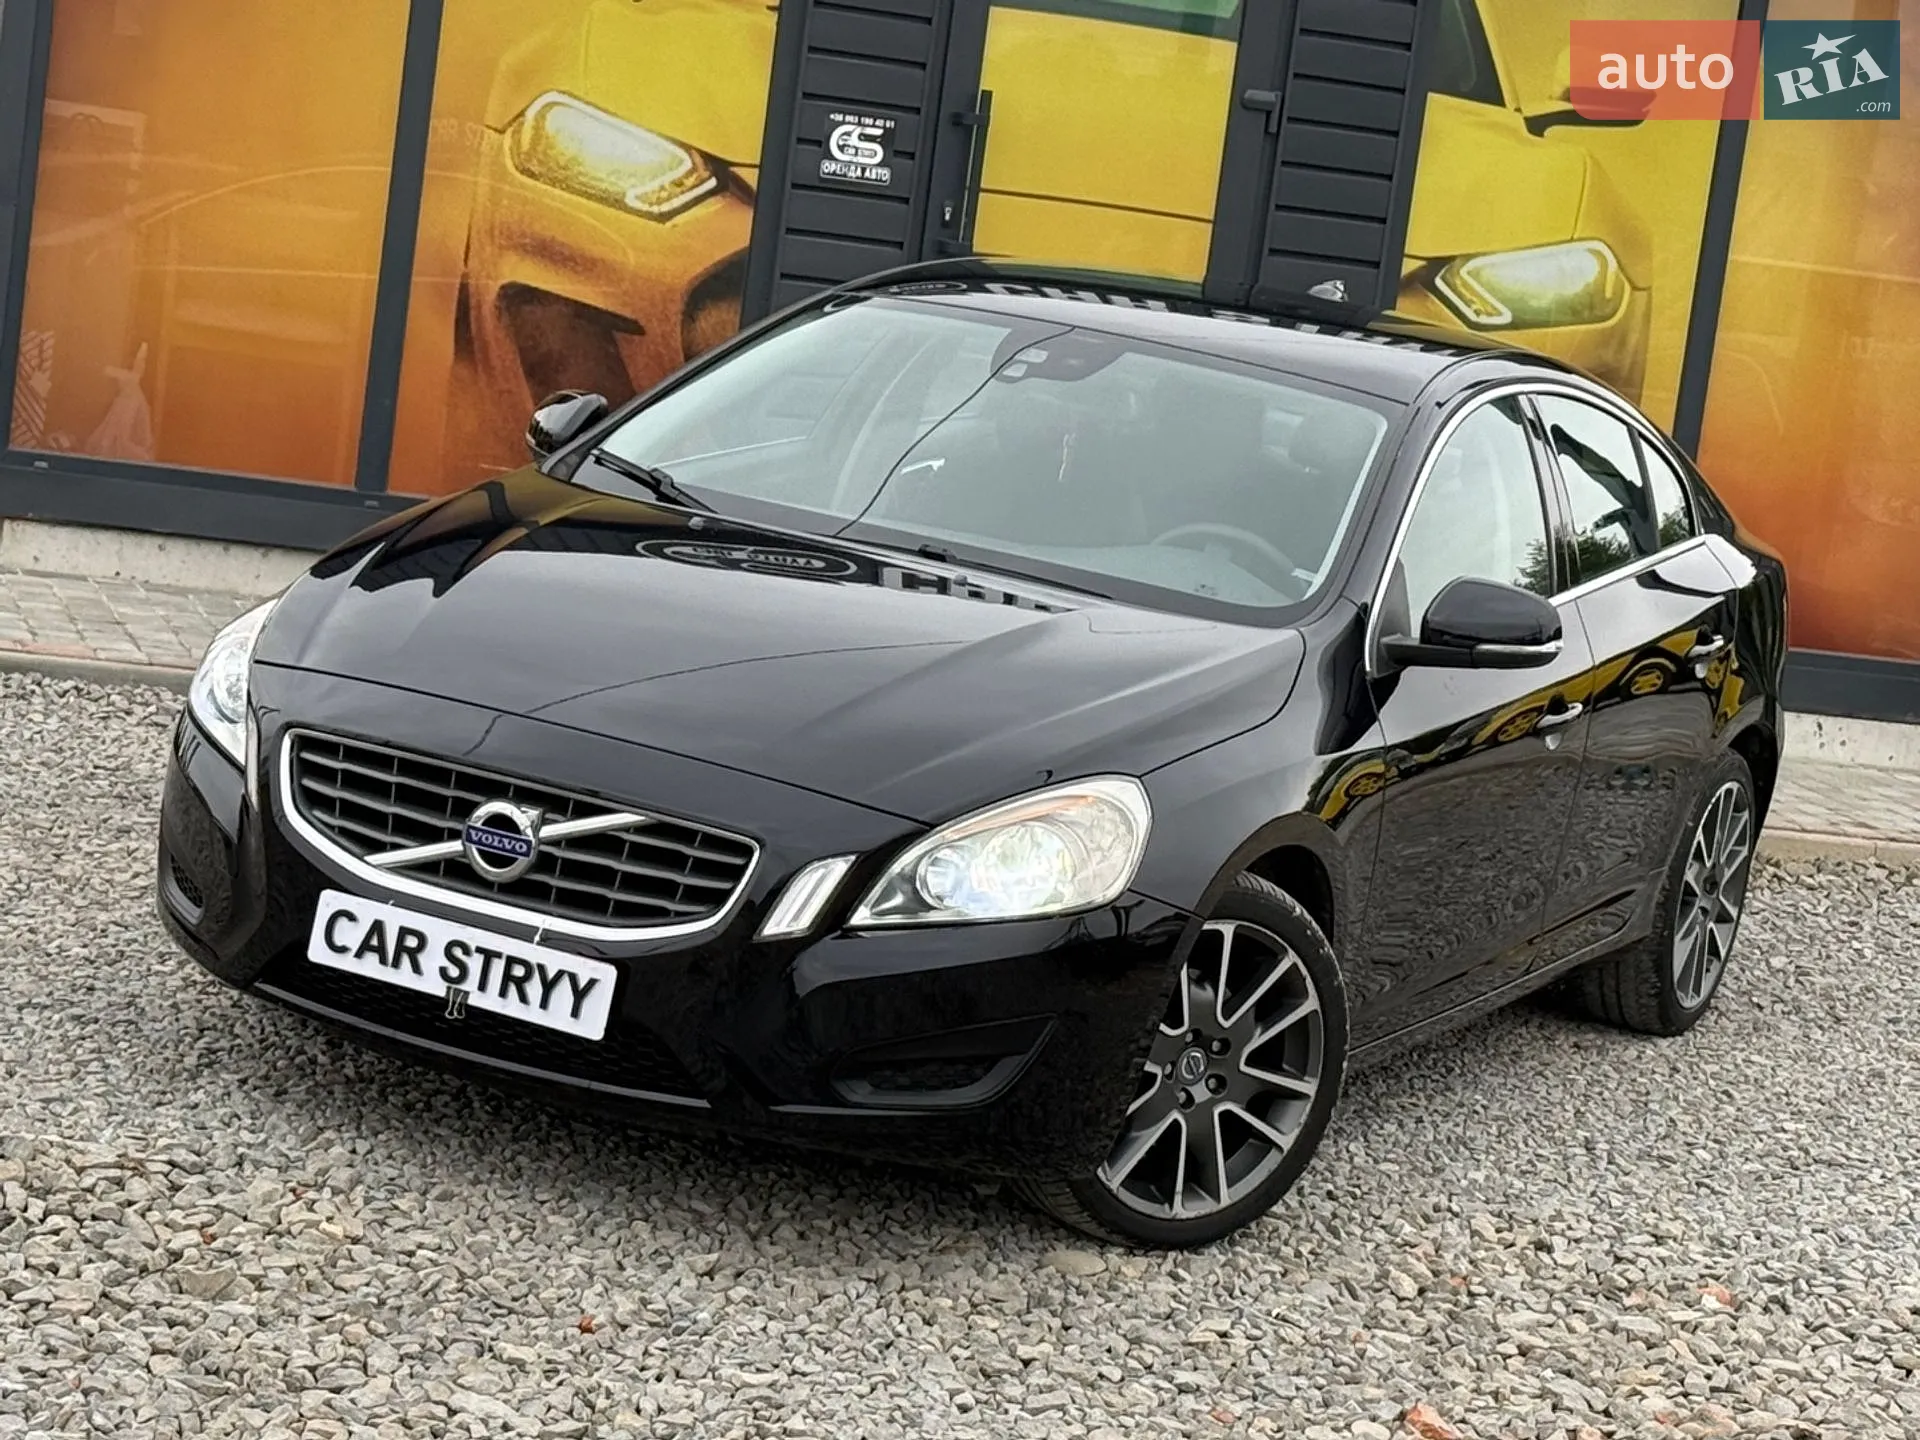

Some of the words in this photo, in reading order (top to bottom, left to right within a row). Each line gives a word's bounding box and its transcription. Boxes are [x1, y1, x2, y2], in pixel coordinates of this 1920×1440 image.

[822, 161, 862, 179] ОРЕНДА
[864, 166, 889, 181] АВТО
[467, 828, 528, 853] VOLVO
[324, 909, 429, 977] CAR
[439, 938, 601, 1020] STRYY
